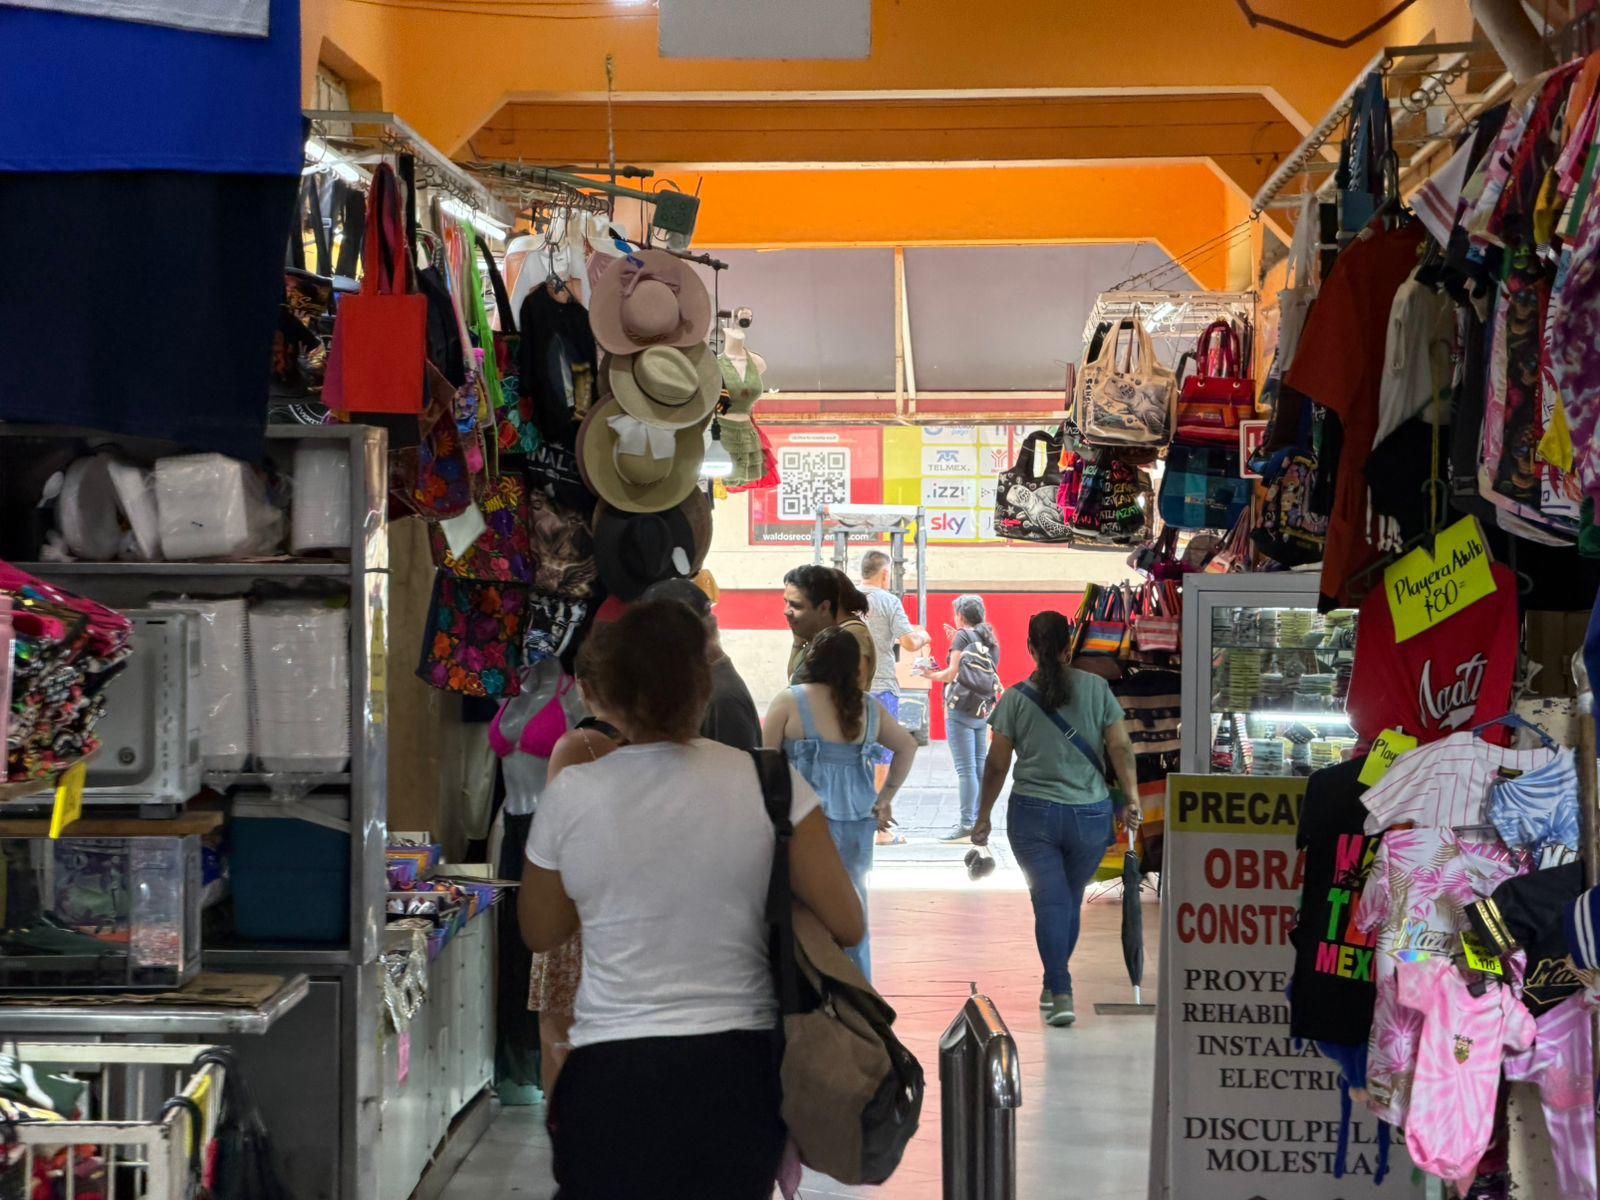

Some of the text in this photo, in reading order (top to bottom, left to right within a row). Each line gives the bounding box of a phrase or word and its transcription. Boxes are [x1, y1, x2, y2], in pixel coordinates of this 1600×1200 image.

[931, 512, 966, 535] sky
[1394, 564, 1452, 605] Playera
[1178, 791, 1304, 826] PRECA
[1327, 887, 1377, 948] TL
[1184, 969, 1287, 993] PROYE
[1184, 1117, 1341, 1143] DISCULPE
[1206, 1148, 1390, 1175] MOLESTA
